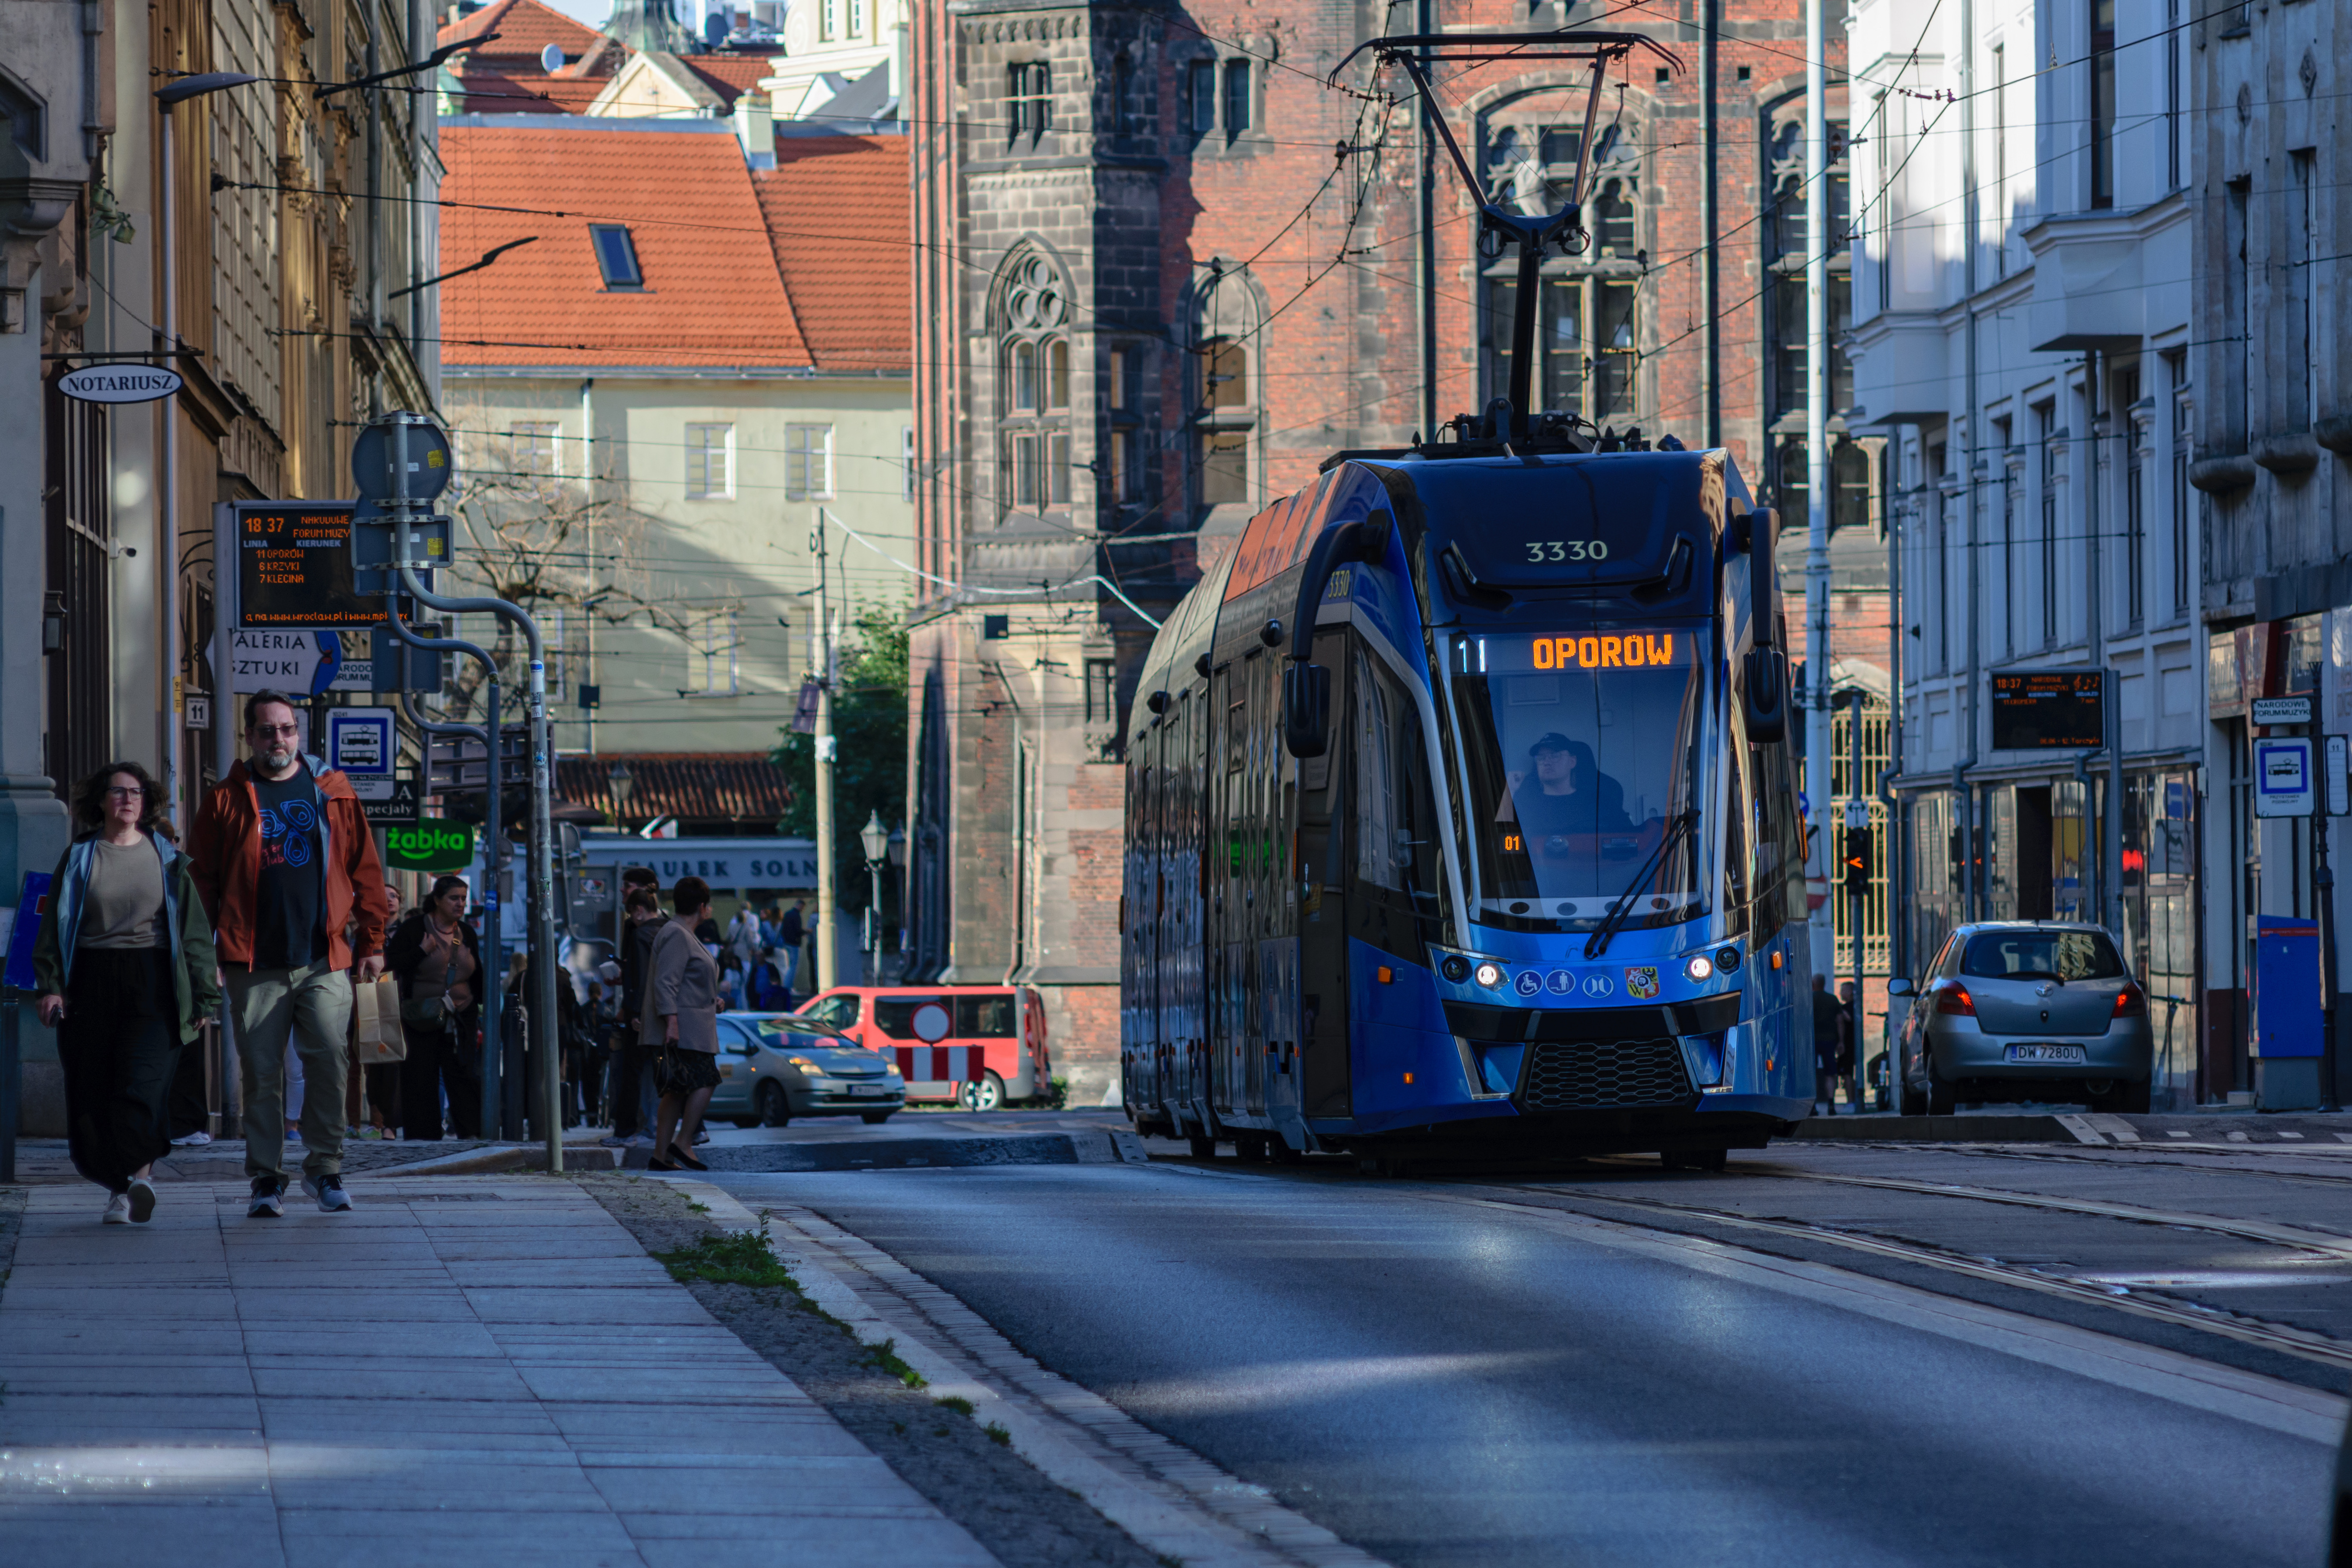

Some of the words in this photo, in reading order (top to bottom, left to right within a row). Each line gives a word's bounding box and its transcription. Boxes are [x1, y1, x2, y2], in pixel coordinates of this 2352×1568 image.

[68, 375, 173, 391] NOTARIUSZ
[293, 529, 323, 538] FORUM
[243, 540, 268, 548] LINIA
[296, 539, 341, 547] KIERUNEK
[256, 549, 265, 559] 11
[267, 548, 304, 558] OPORÓW
[1526, 540, 1608, 562] 3330
[259, 562, 265, 571] 6
[267, 562, 299, 571] KRZYKI
[259, 575, 265, 583] 7
[267, 575, 304, 583] KLECINA
[270, 612, 342, 621] www.wroclaw.pl
[345, 611, 348, 620] i
[1458, 640, 1485, 673] 11
[1533, 634, 1672, 670] OPORÓW
[1996, 678, 2021, 689] 18:37
[192, 705, 203, 719] 11
[397, 785, 413, 800] A
[387, 827, 465, 850] żabka
[1505, 836, 1519, 850] 01
[628, 860, 728, 877] AUŁEK
[2018, 1046, 2036, 1058] DW
[2040, 1046, 2078, 1059] 7280U
